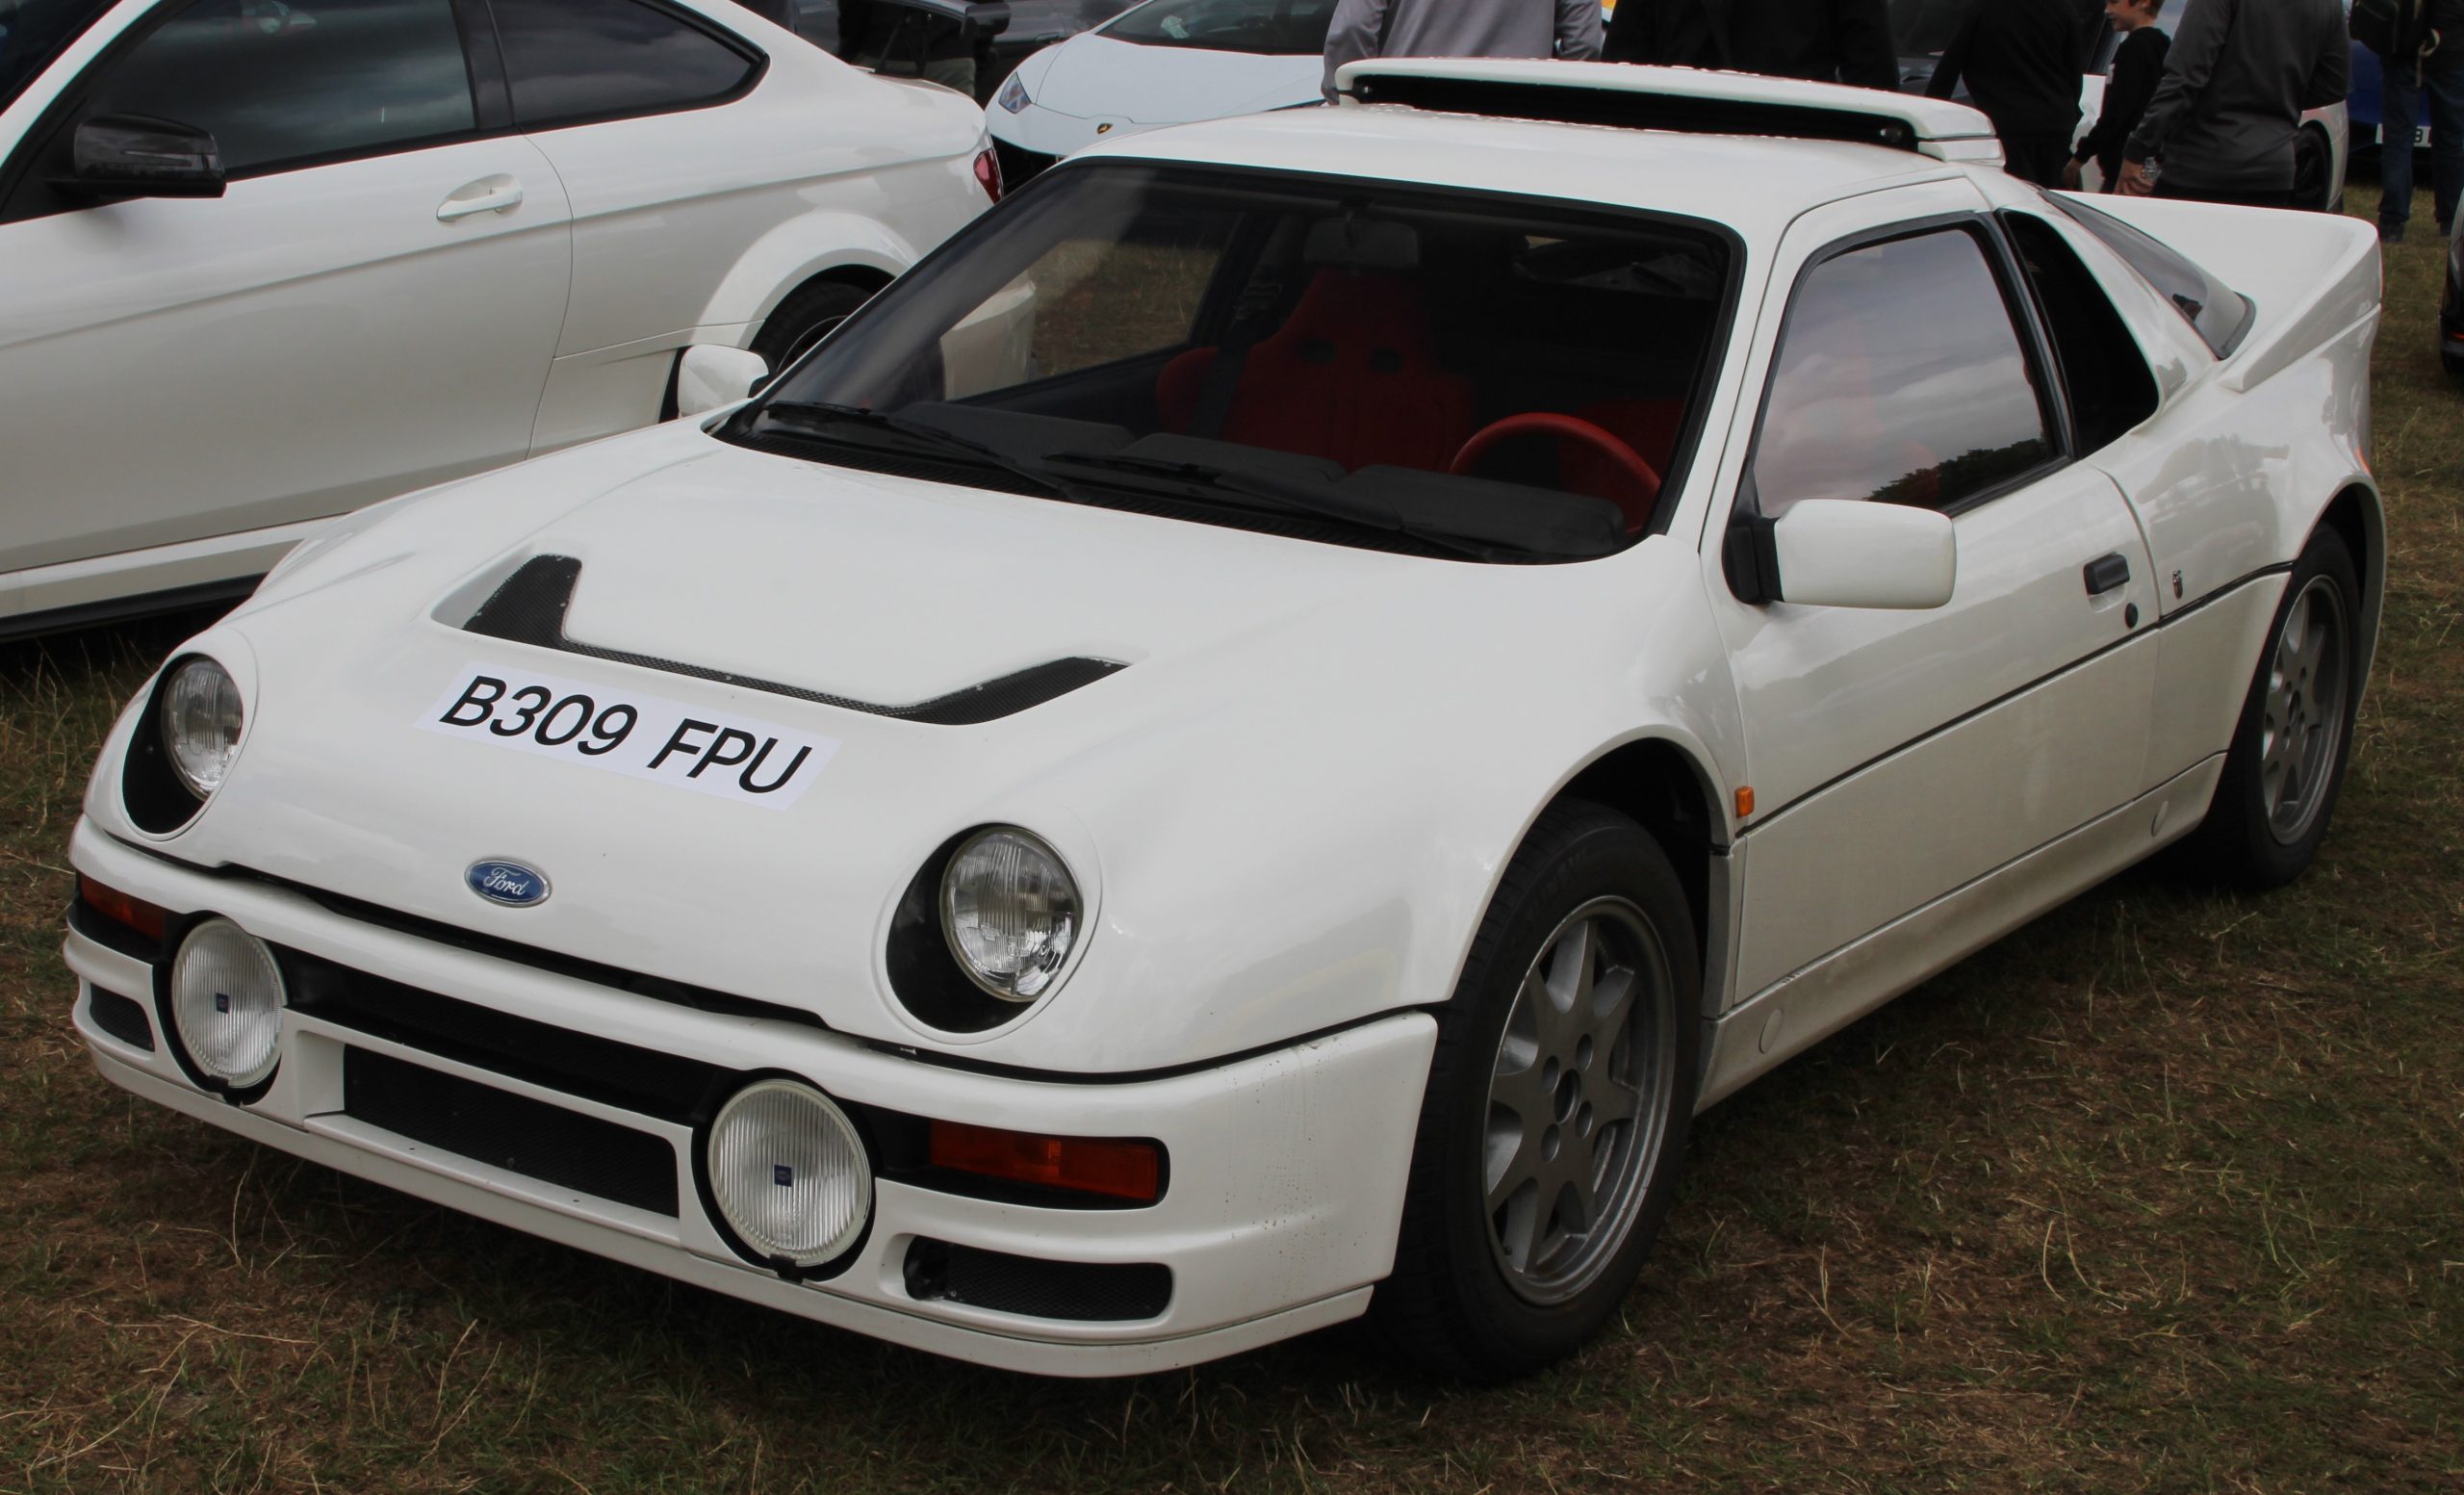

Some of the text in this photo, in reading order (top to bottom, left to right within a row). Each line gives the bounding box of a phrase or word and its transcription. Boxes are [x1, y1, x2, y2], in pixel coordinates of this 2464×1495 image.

[439, 675, 813, 793] B309 FPU
[482, 866, 530, 895] Ford
